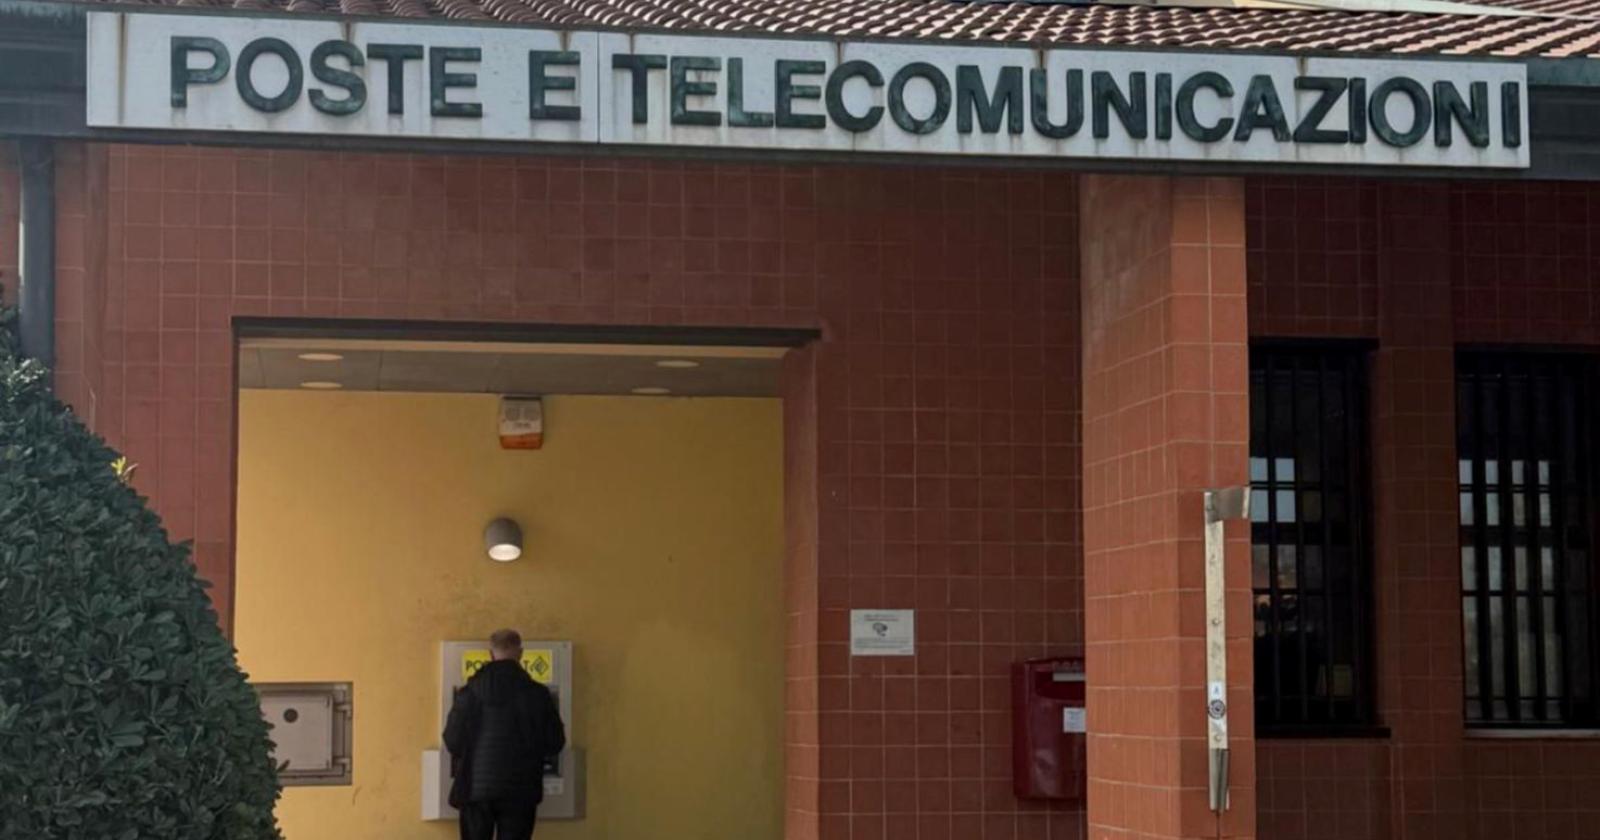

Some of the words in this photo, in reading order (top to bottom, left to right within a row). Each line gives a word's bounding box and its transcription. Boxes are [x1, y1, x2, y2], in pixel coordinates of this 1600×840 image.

[170, 36, 483, 118] POSTE
[529, 50, 582, 121] E
[612, 53, 1521, 148] TELECOMUNICAZIONI
